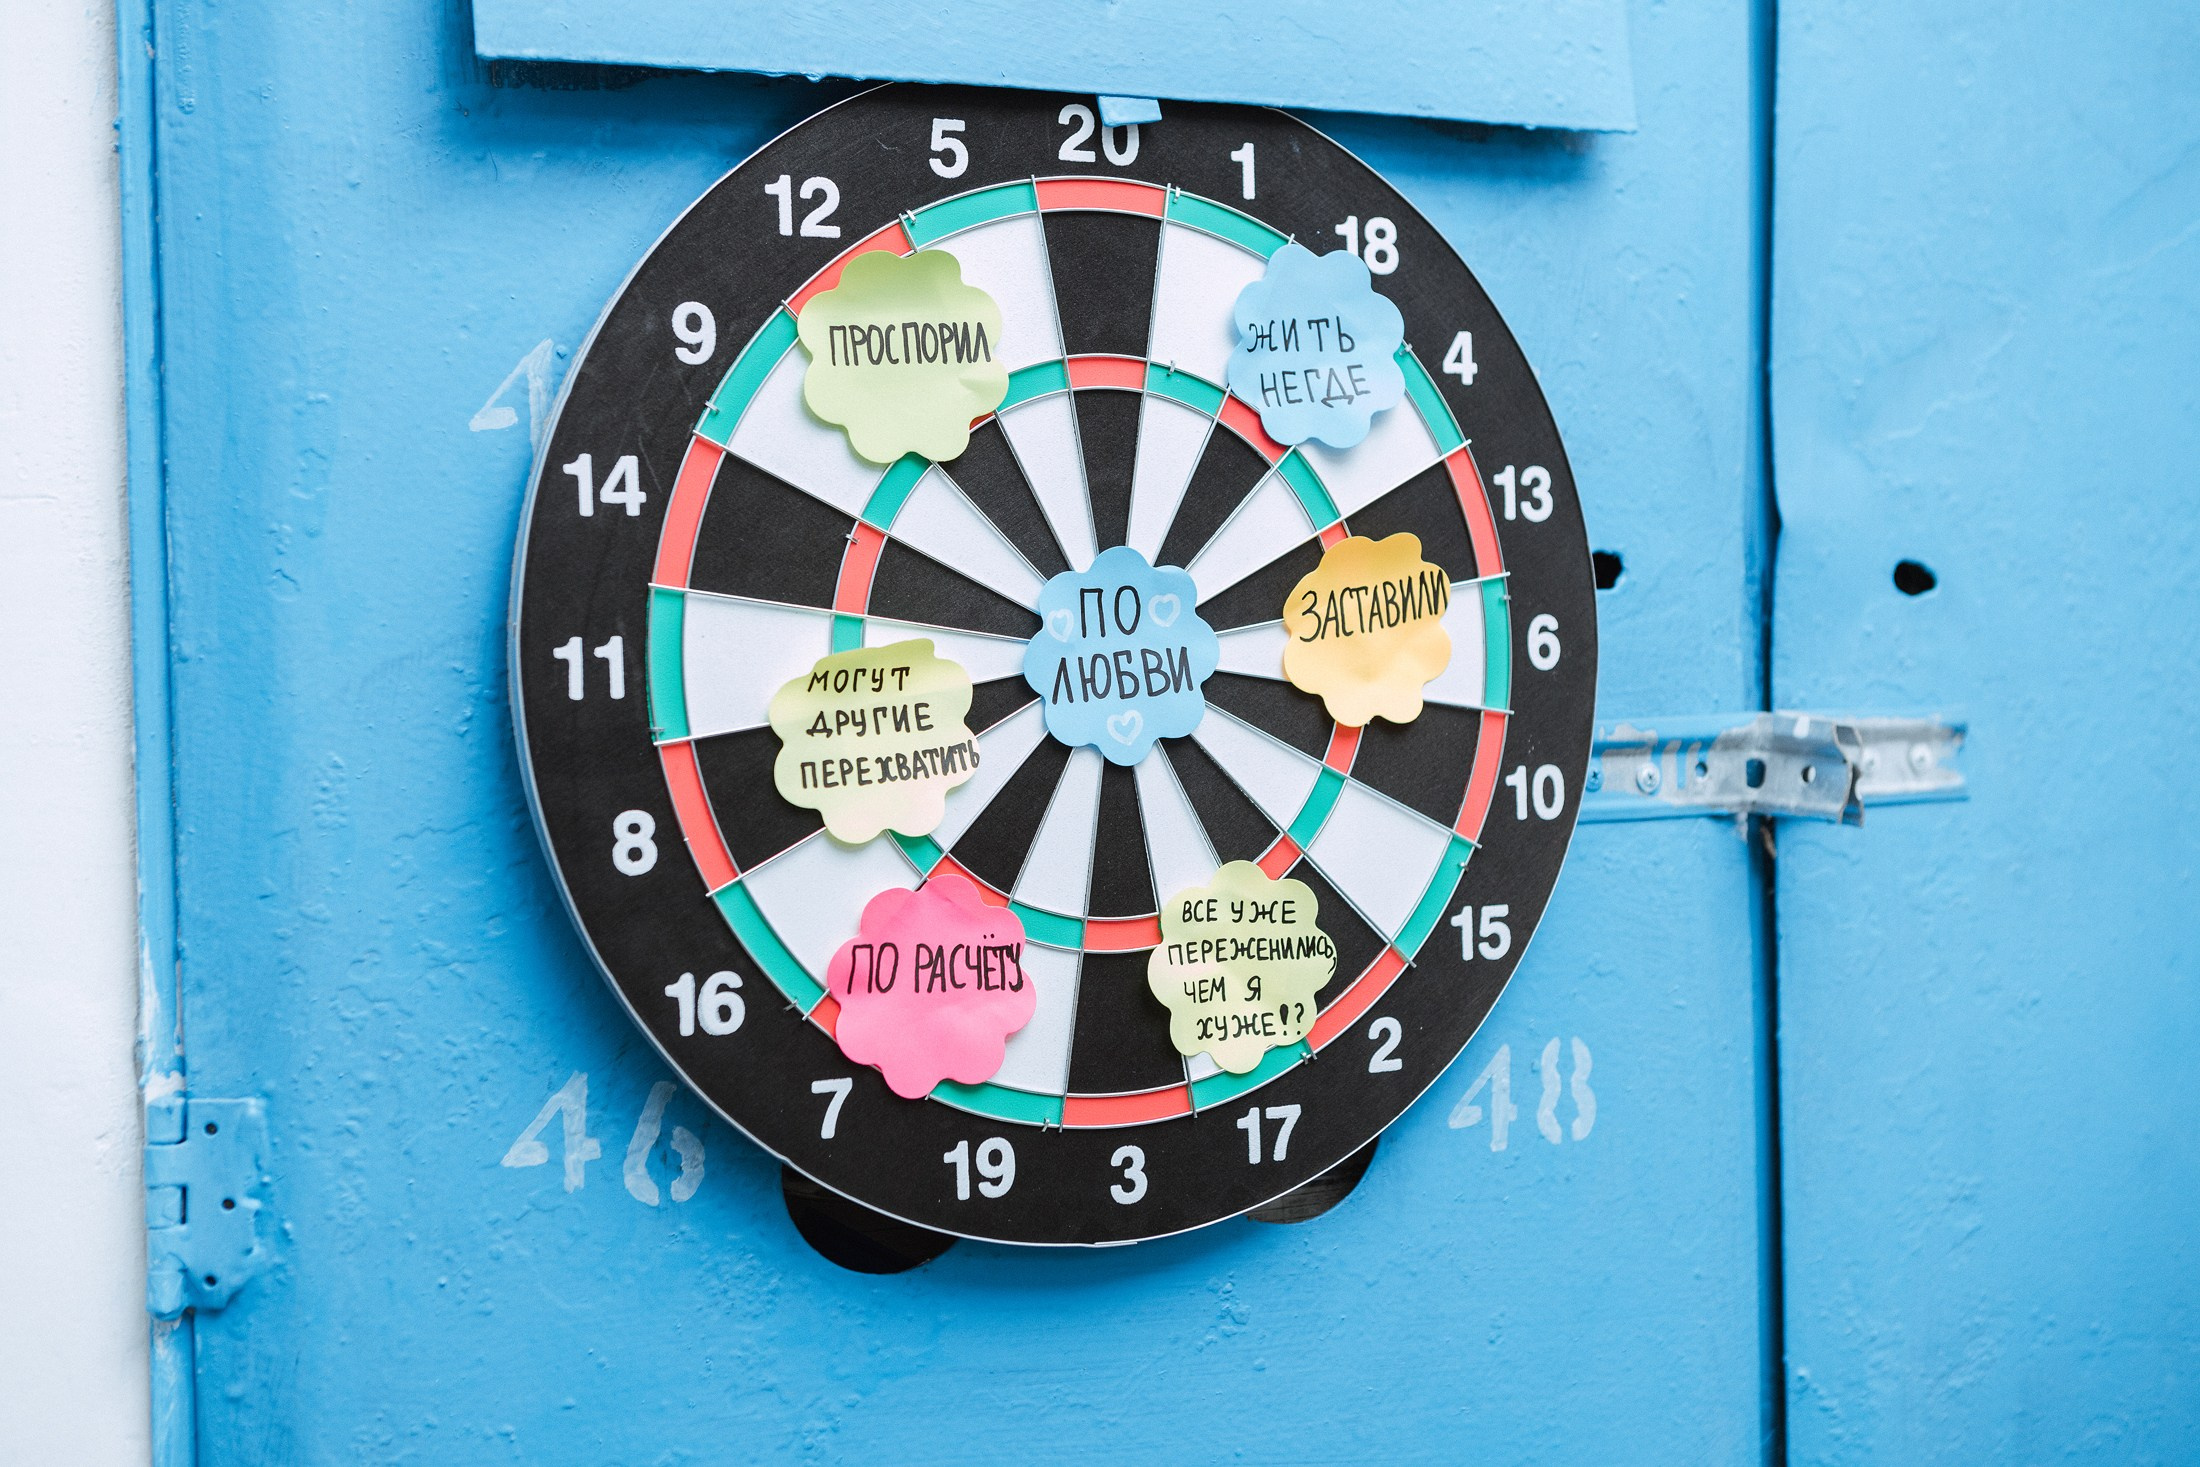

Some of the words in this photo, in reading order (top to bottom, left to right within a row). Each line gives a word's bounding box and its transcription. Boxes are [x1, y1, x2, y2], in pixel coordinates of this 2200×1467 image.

[929, 118, 968, 178] 5
[1058, 104, 1139, 166] 20
[1231, 143, 1256, 200] 1
[765, 175, 840, 238] 12
[1335, 216, 1399, 275] 18
[672, 302, 716, 365] 9
[829, 322, 990, 366] ПРОСПОРИЛ
[1247, 316, 1355, 353] ЖИТЬ
[1443, 331, 1478, 385] 4
[1260, 365, 1371, 407] НЕГДЕ
[563, 453, 646, 517] 14
[1493, 465, 1553, 522] 13
[1080, 586, 1140, 638] ПО
[1300, 569, 1448, 642] ЗАСТАВИЛИ
[553, 635, 625, 699] 11
[1527, 613, 1561, 670] 6
[807, 666, 911, 693] МОГУТ
[1052, 647, 1194, 703] ЛЮБВИ
[806, 703, 933, 738] ДРУГИЕ
[800, 740, 980, 789] ПЕРЕХВАТИТЬ
[1506, 764, 1566, 820] 10
[612, 810, 658, 876] 8
[1182, 899, 1218, 923] ВСЕ
[1232, 900, 1297, 924] УЖЕ
[1451, 904, 1512, 961] 15
[847, 944, 898, 994] ПО
[915, 934, 1023, 994] РАСЧЁТУ
[1184, 978, 1226, 1004] ЧЕМ
[1246, 976, 1261, 1002] Я
[665, 971, 746, 1036] 16
[1197, 1003, 1305, 1041] ХУЖЕ!?
[1368, 1017, 1403, 1073] 2
[811, 1077, 852, 1139] 7
[1448, 1037, 1597, 1152] 48
[1237, 1104, 1302, 1165] 17
[944, 1137, 1016, 1200] 19
[1110, 1145, 1148, 1204] 3
